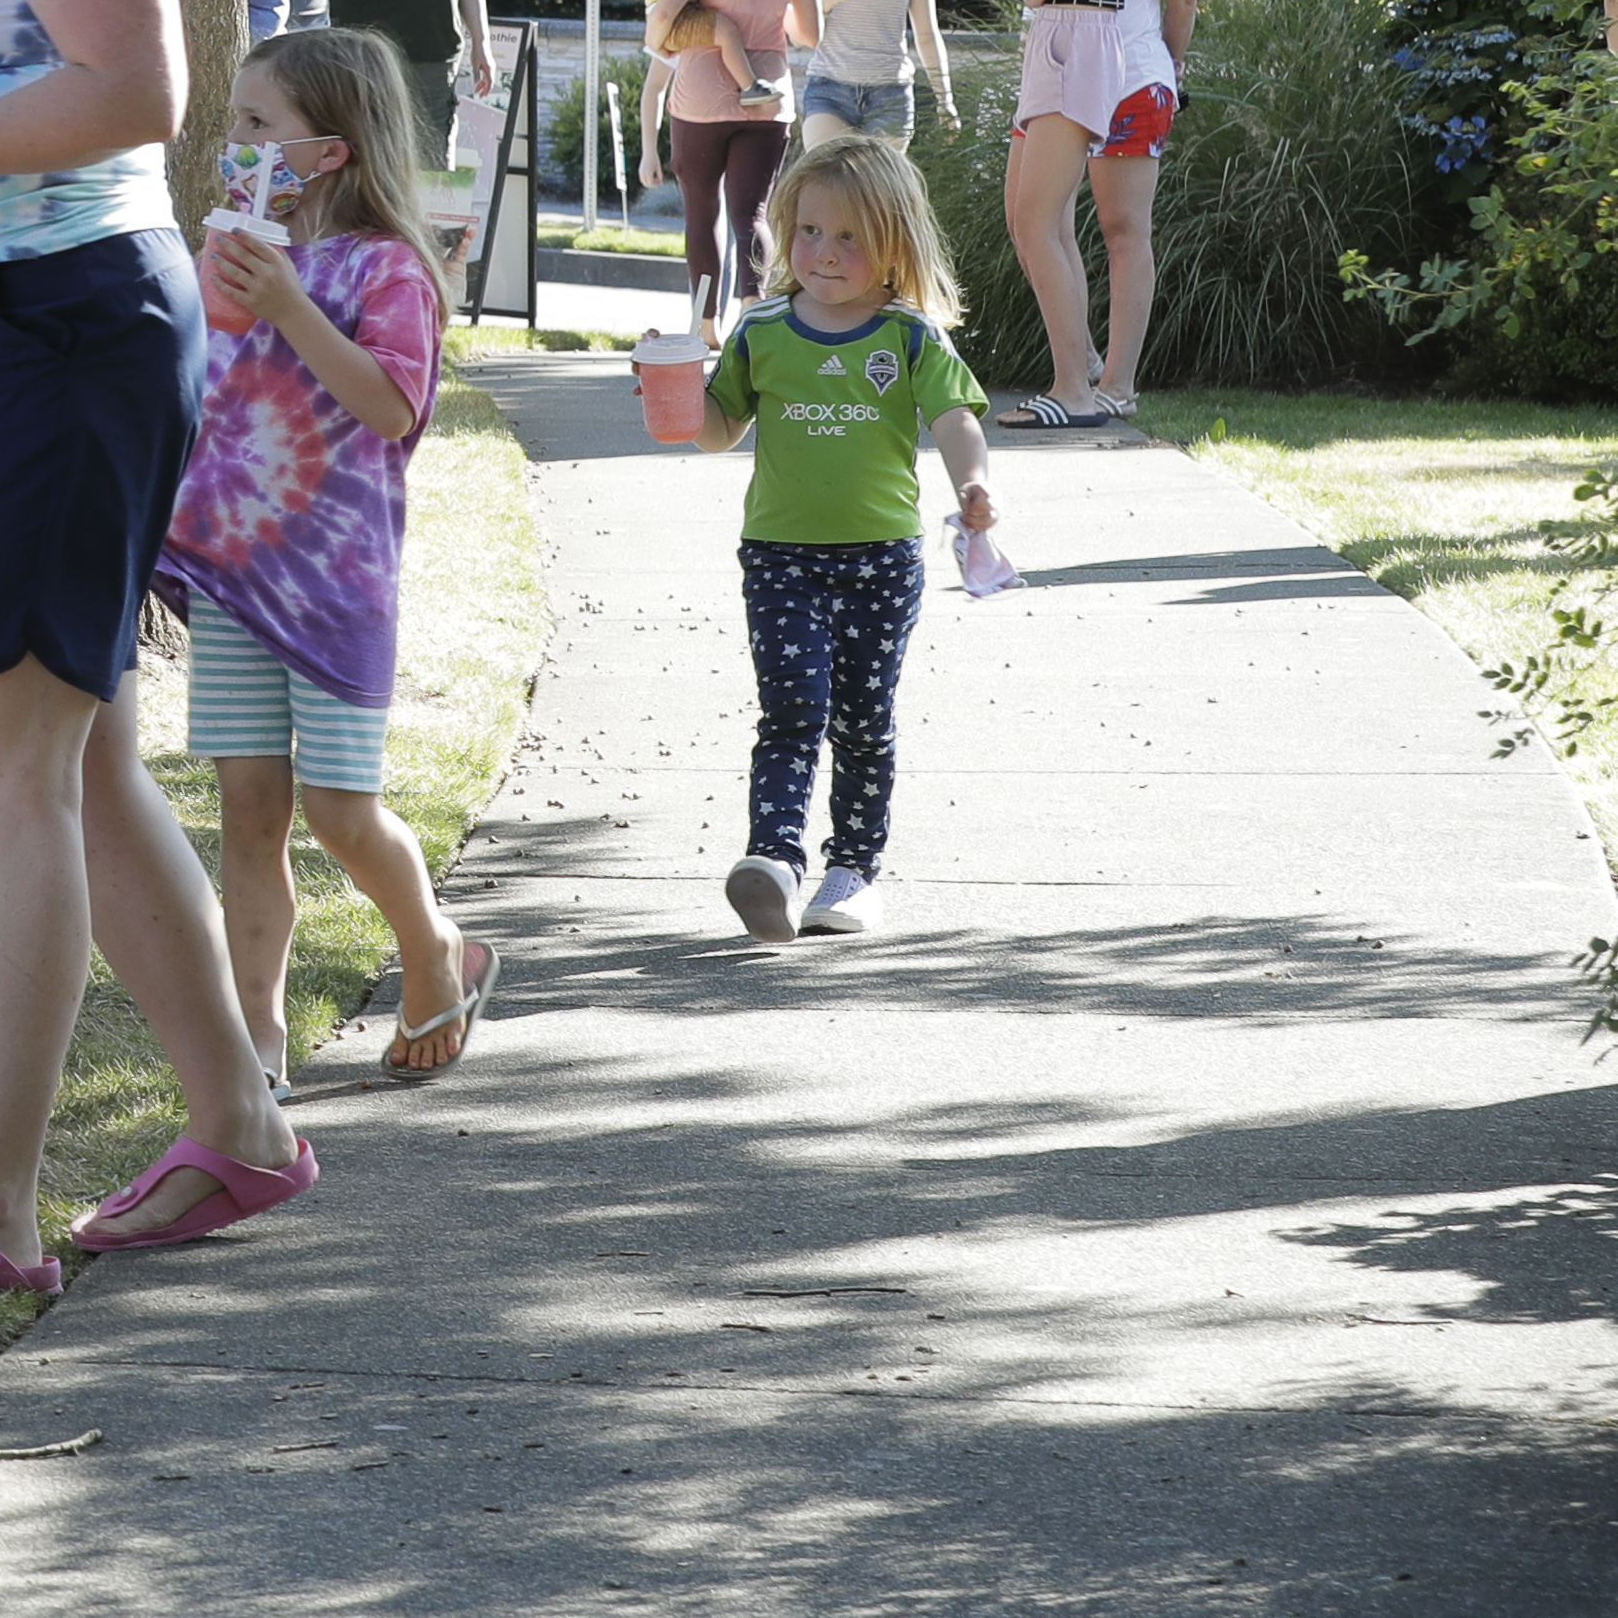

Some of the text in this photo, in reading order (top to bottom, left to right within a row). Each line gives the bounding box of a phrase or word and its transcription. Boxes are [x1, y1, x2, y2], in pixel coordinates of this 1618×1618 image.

[817, 367, 847, 376] adidas
[780, 403, 836, 421] XBOX
[807, 425, 846, 436] LIVE
